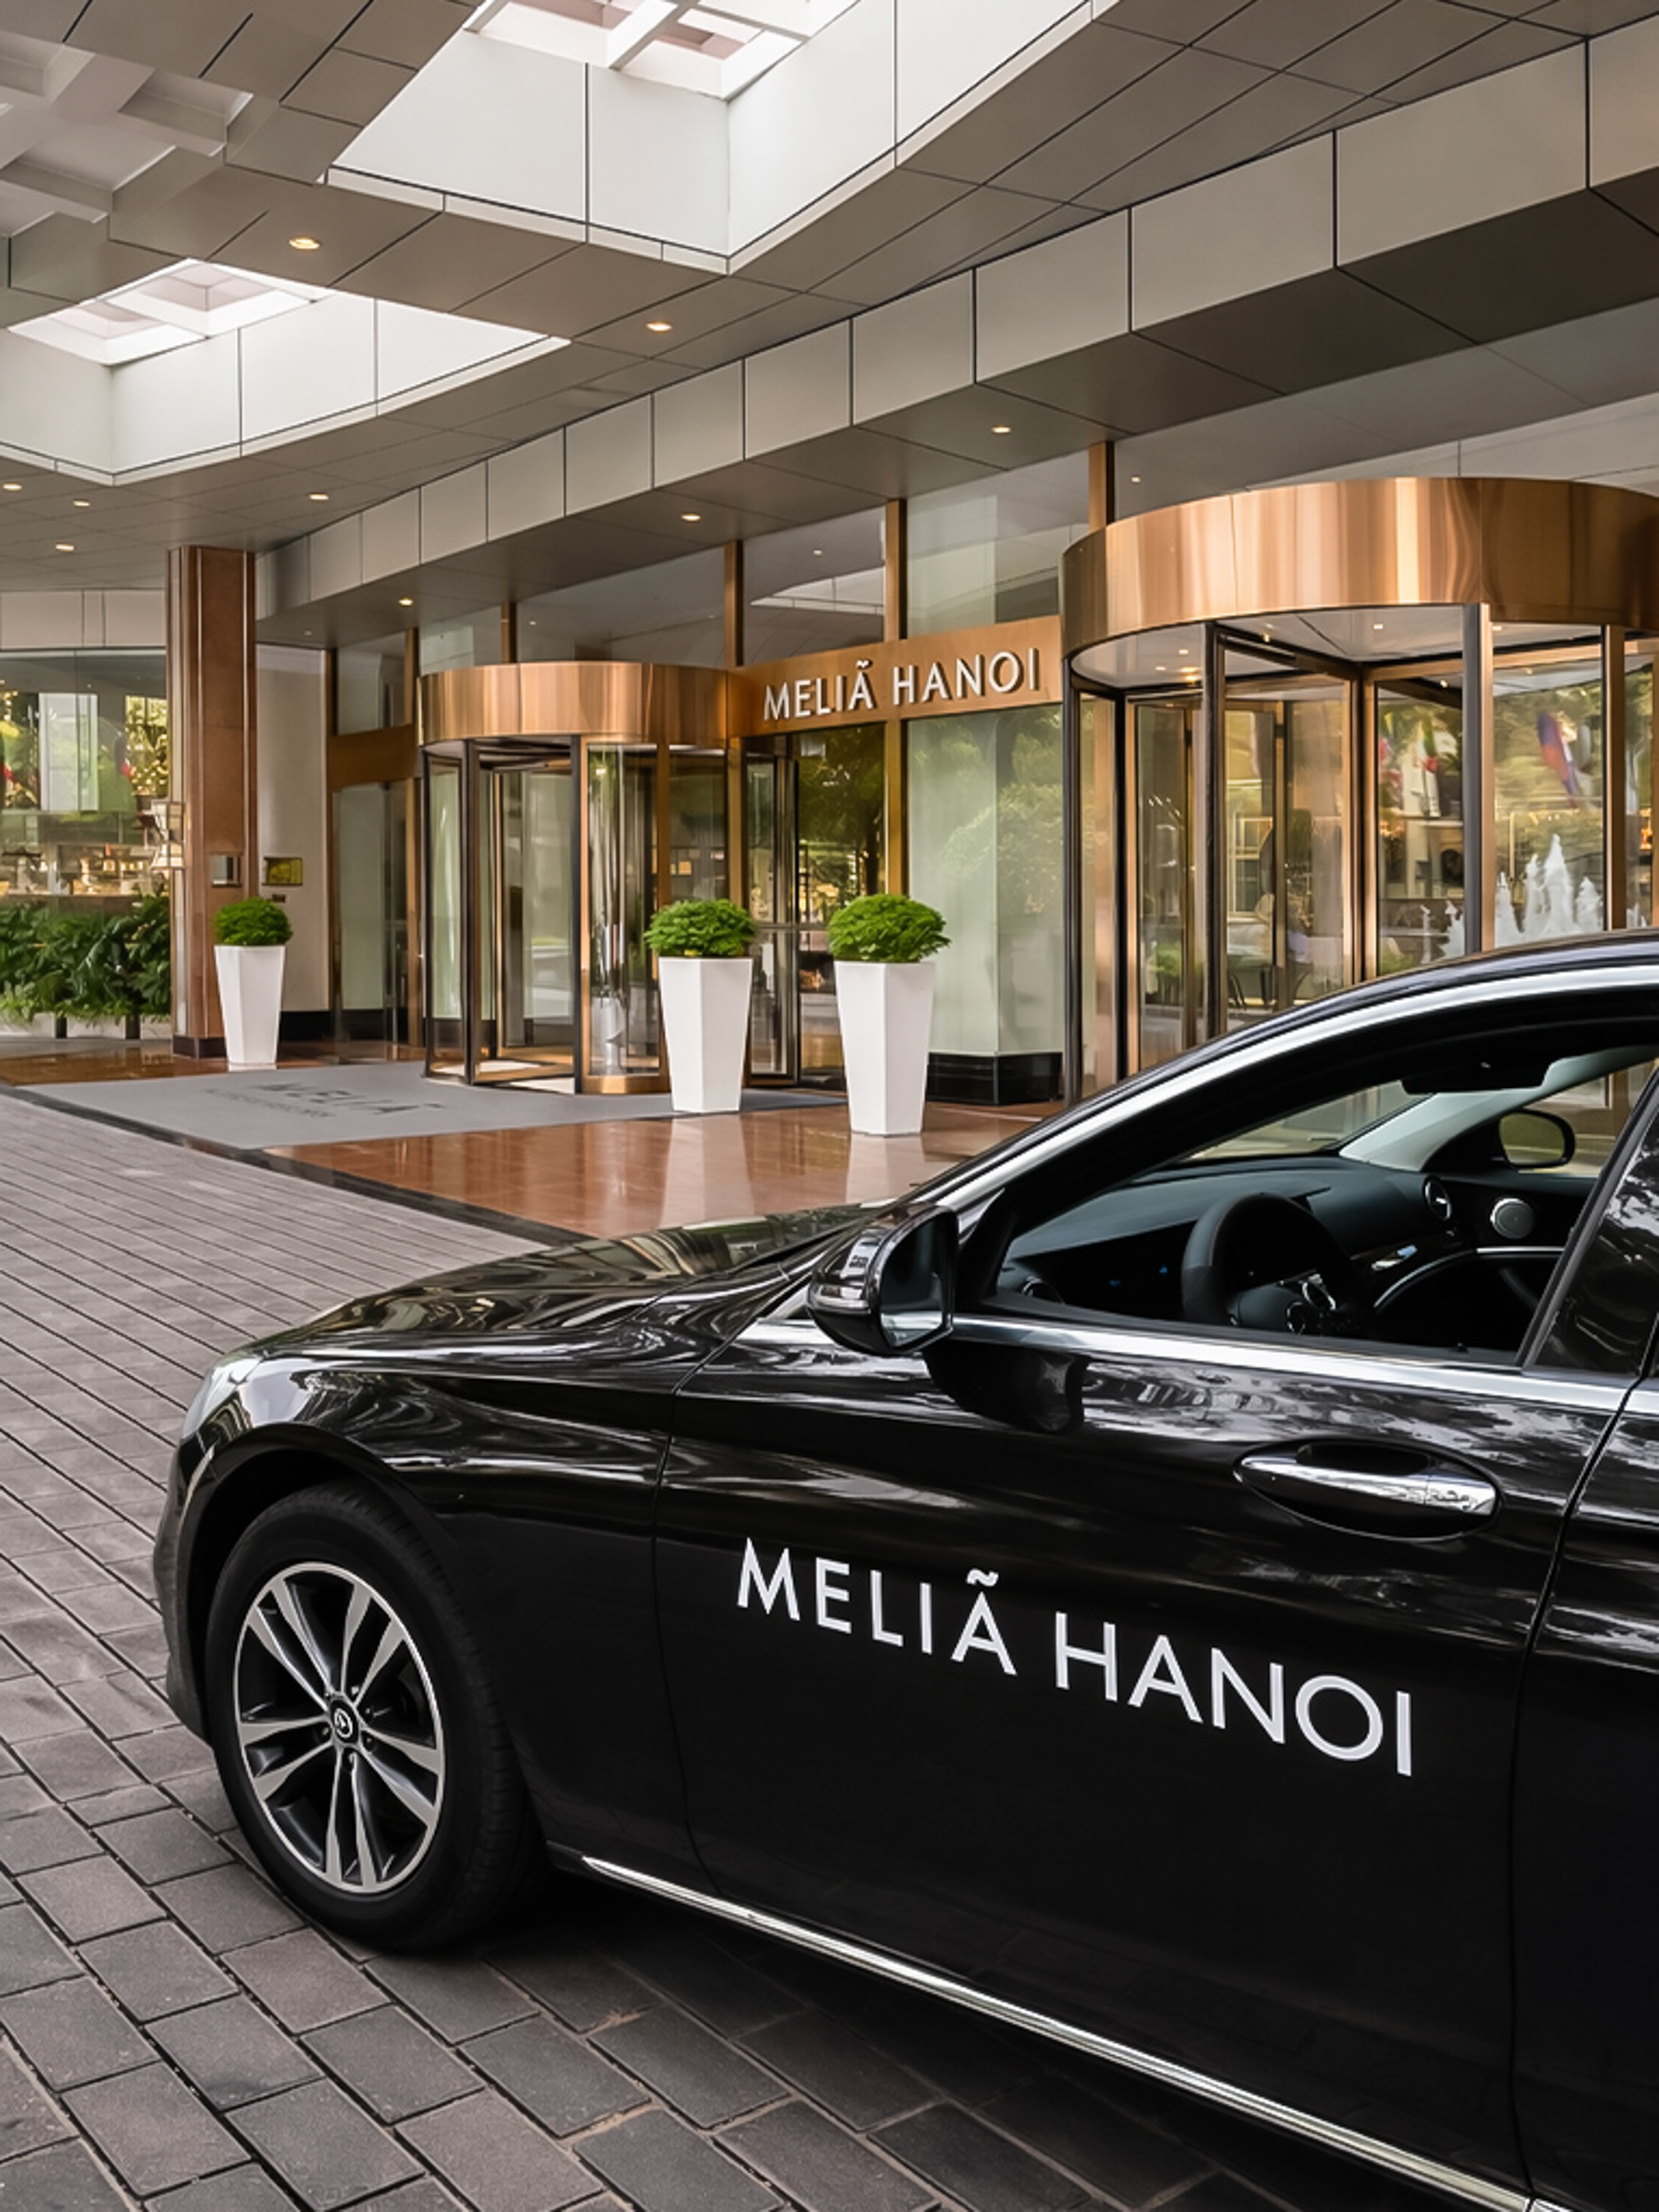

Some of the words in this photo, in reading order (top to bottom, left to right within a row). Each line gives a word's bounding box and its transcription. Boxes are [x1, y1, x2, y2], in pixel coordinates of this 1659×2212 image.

[764, 660, 875, 721] MELIÃ
[893, 647, 1038, 706] HANOI
[737, 1538, 1017, 1675] MELIÃ
[1055, 1611, 1412, 1776] HANOI
